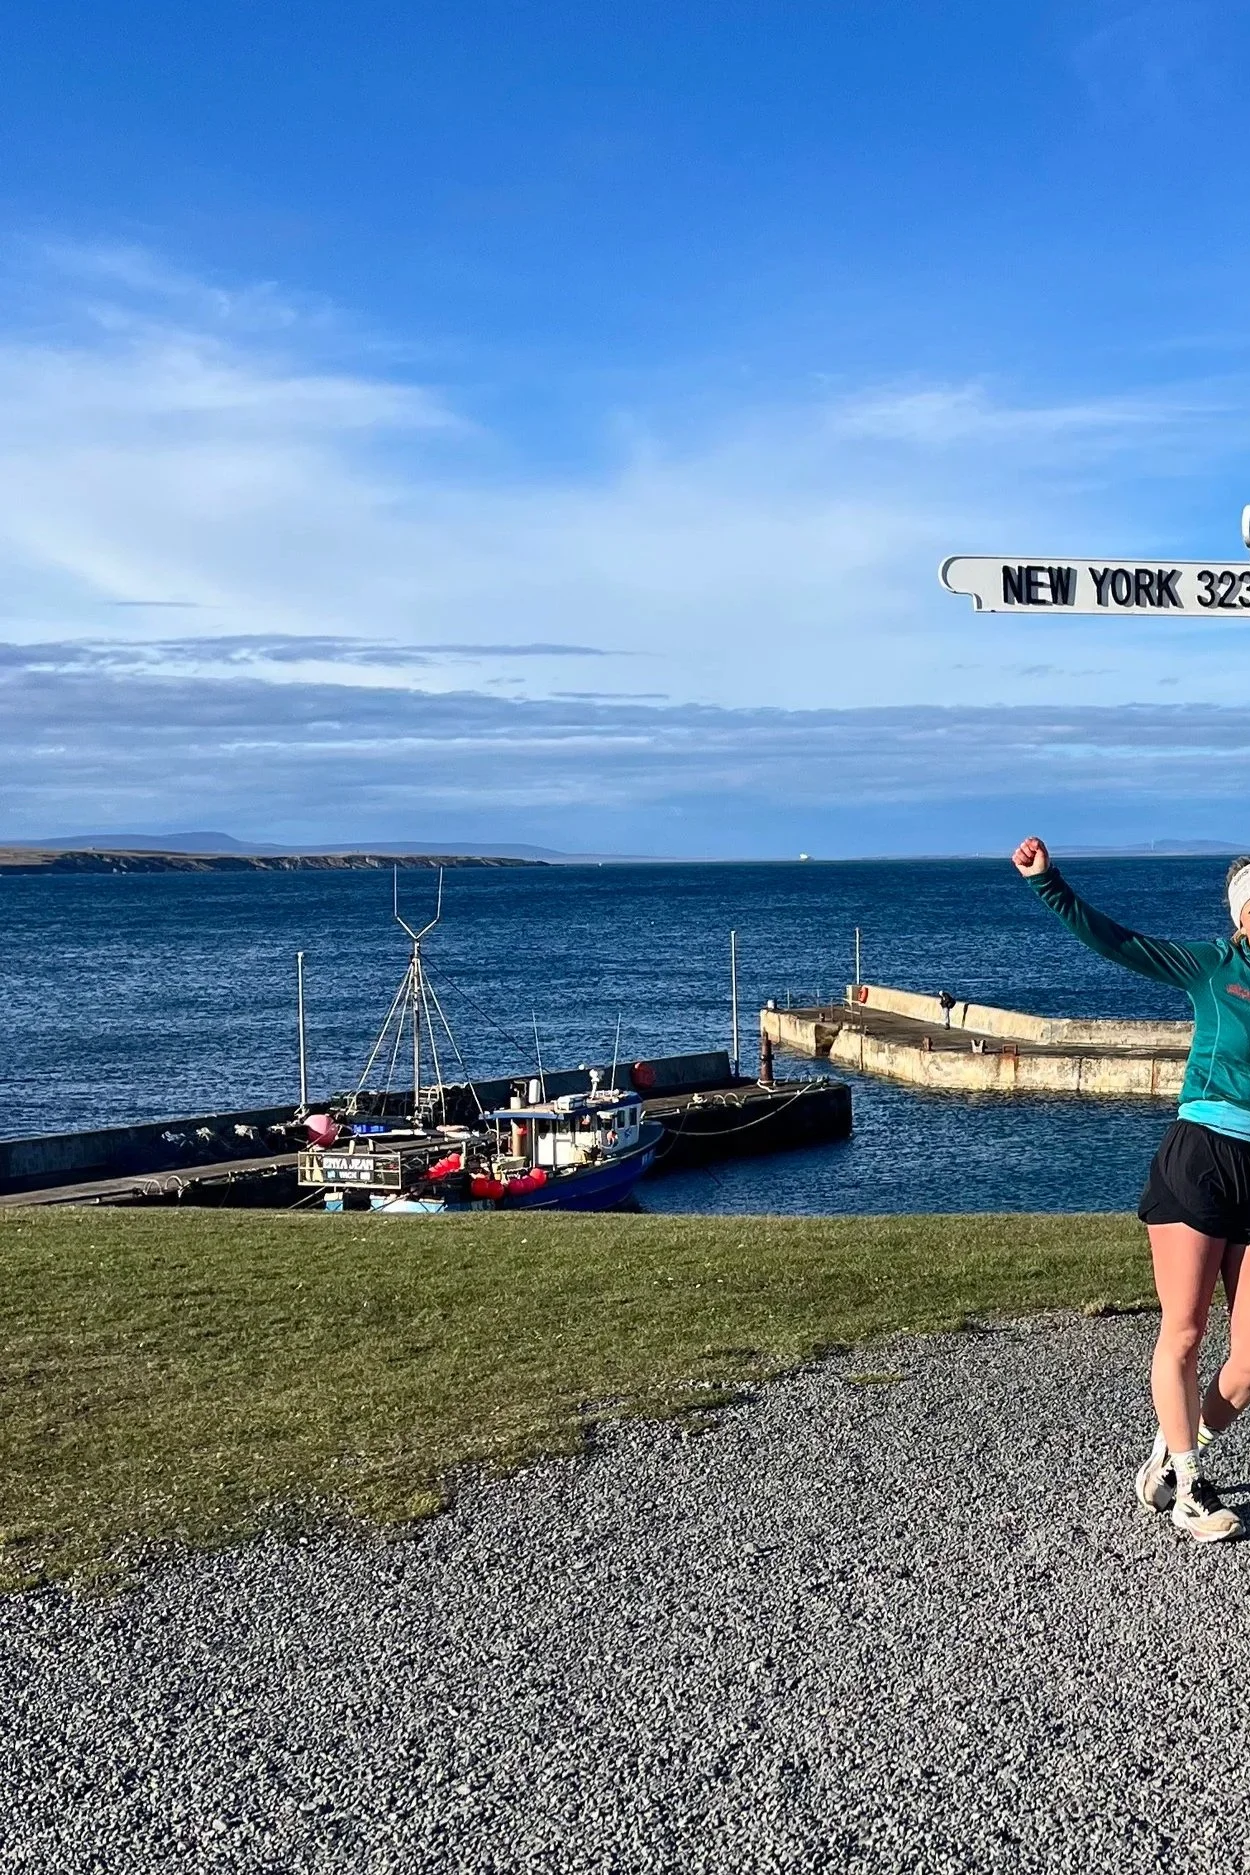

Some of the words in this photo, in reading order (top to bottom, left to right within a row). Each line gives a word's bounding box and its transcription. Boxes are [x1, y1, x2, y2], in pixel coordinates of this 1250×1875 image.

[1002, 565, 1075, 606] NEW
[1089, 566, 1179, 608] YORK
[349, 1158, 374, 1171] JEAN
